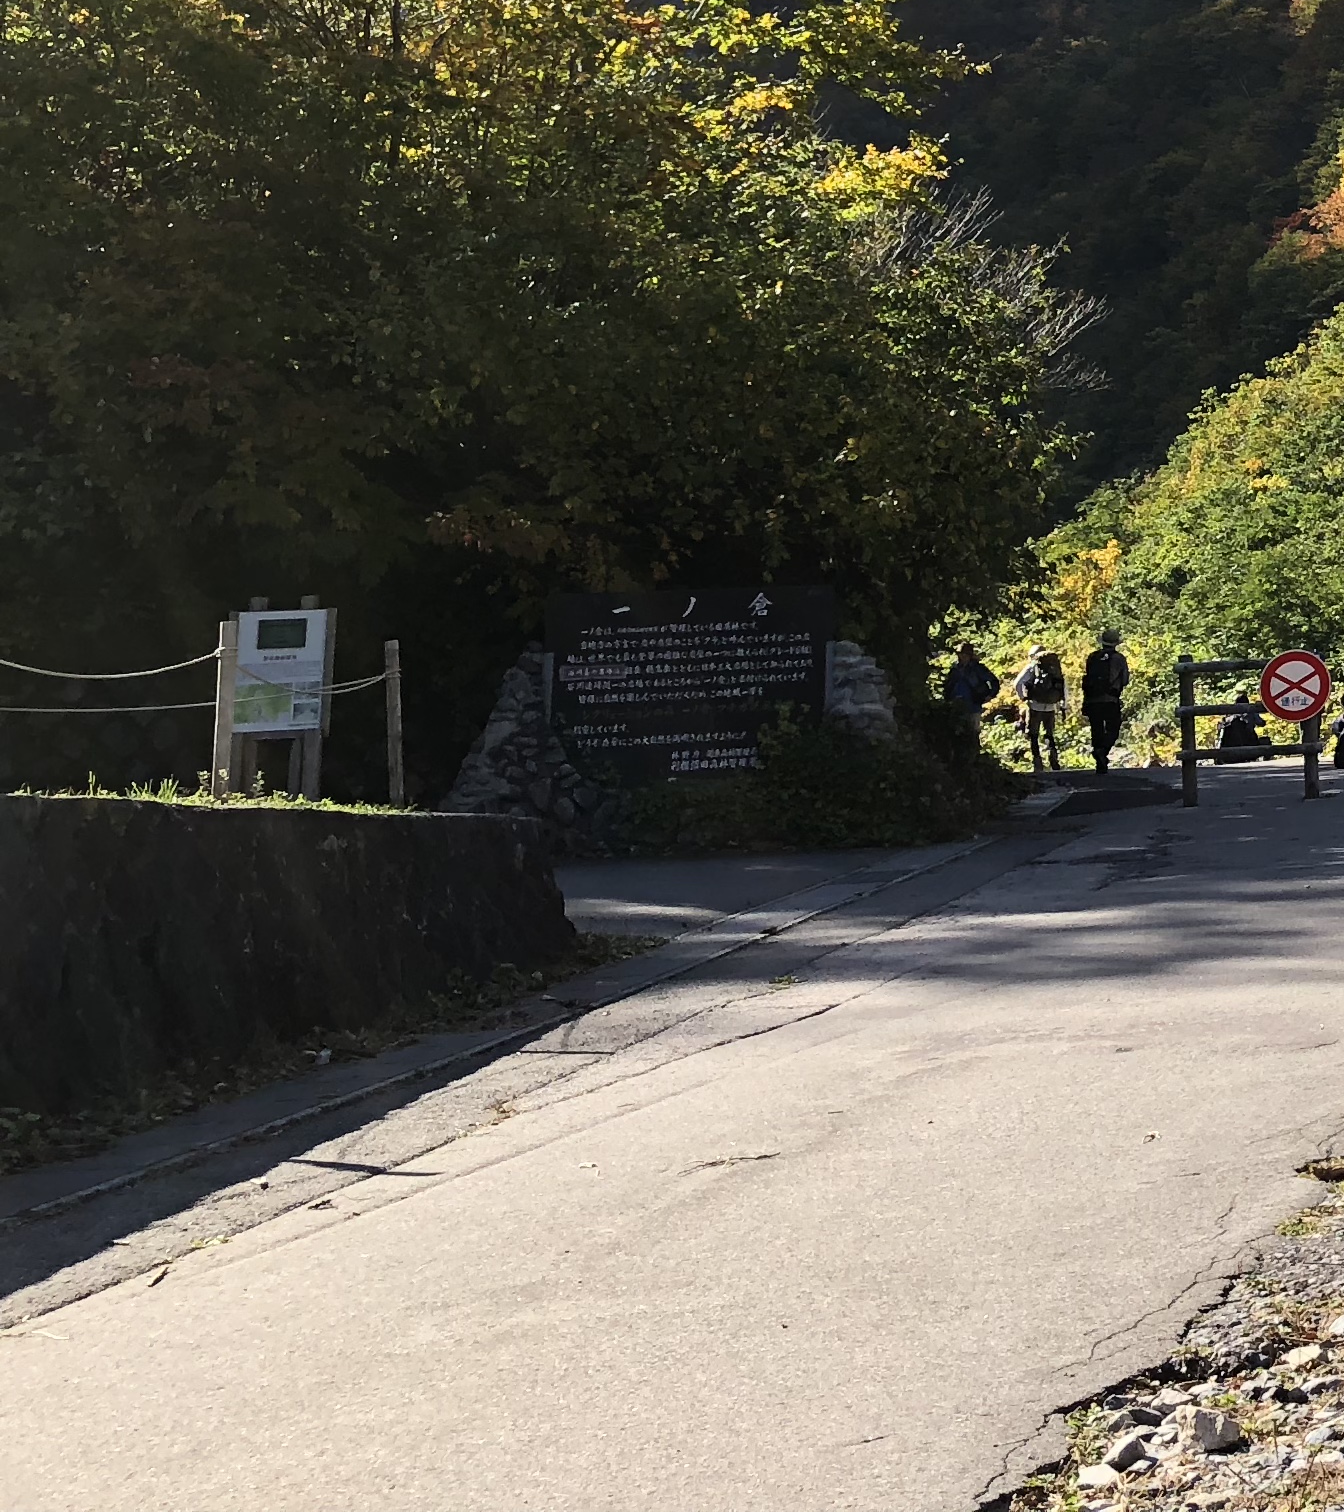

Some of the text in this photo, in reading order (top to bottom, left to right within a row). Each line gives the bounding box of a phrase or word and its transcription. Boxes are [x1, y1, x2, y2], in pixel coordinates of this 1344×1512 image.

[611, 592, 773, 618] 一ノ倉
[1280, 695, 1309, 706] 通行止
